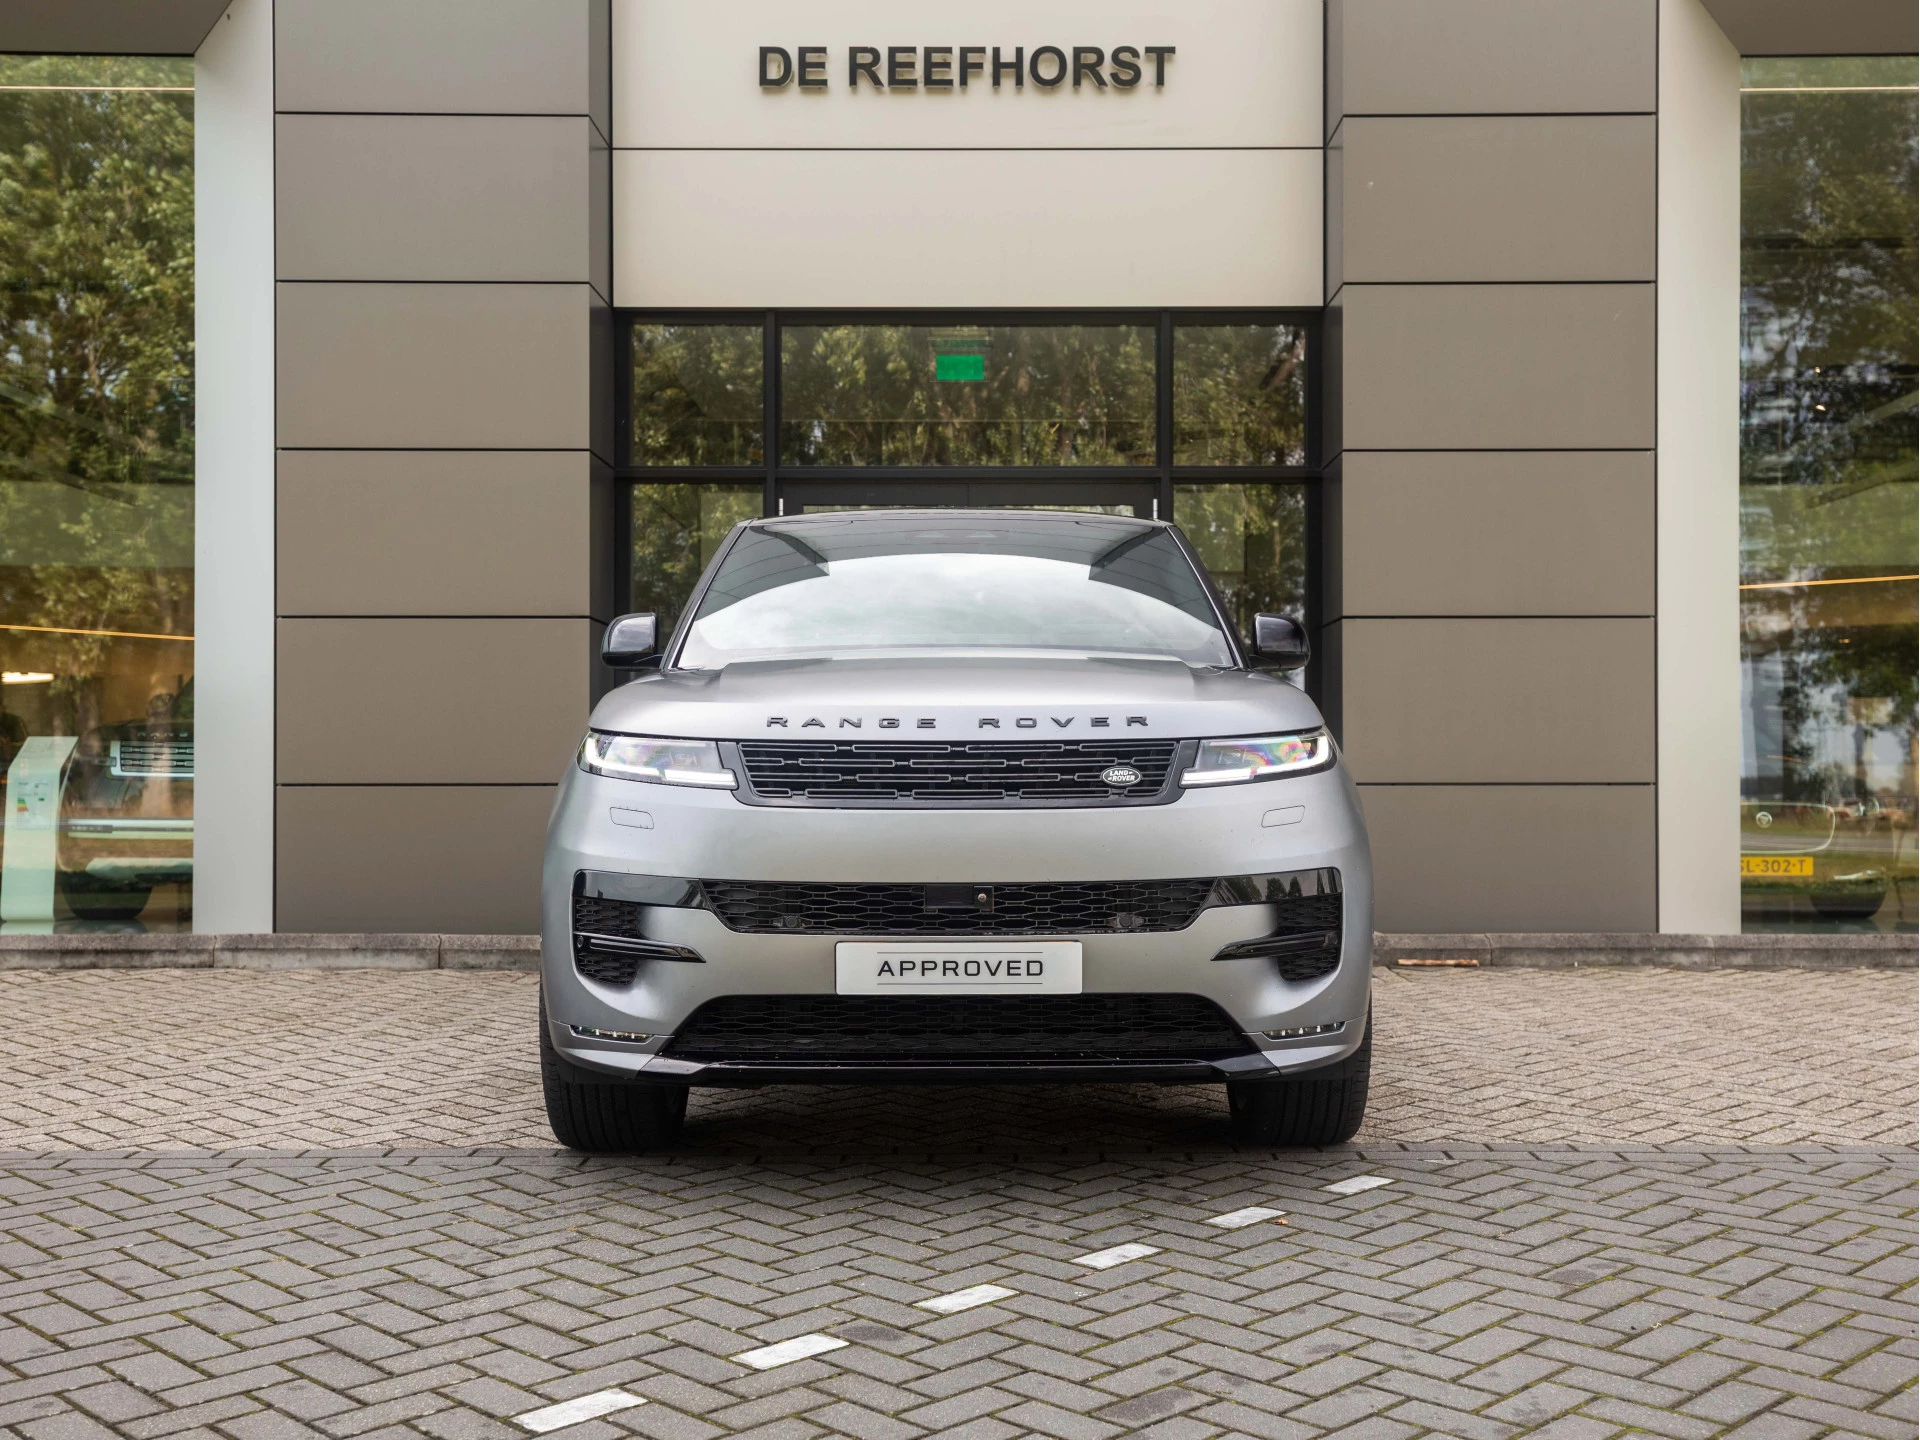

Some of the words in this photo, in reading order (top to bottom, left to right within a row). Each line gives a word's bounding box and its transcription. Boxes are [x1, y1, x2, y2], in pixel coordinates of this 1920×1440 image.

[758, 45, 829, 88] DE
[848, 45, 1177, 88] REEFHORST
[766, 715, 937, 729] RANGE
[978, 715, 1149, 729] ROVER
[877, 960, 1044, 977] APPROVED
